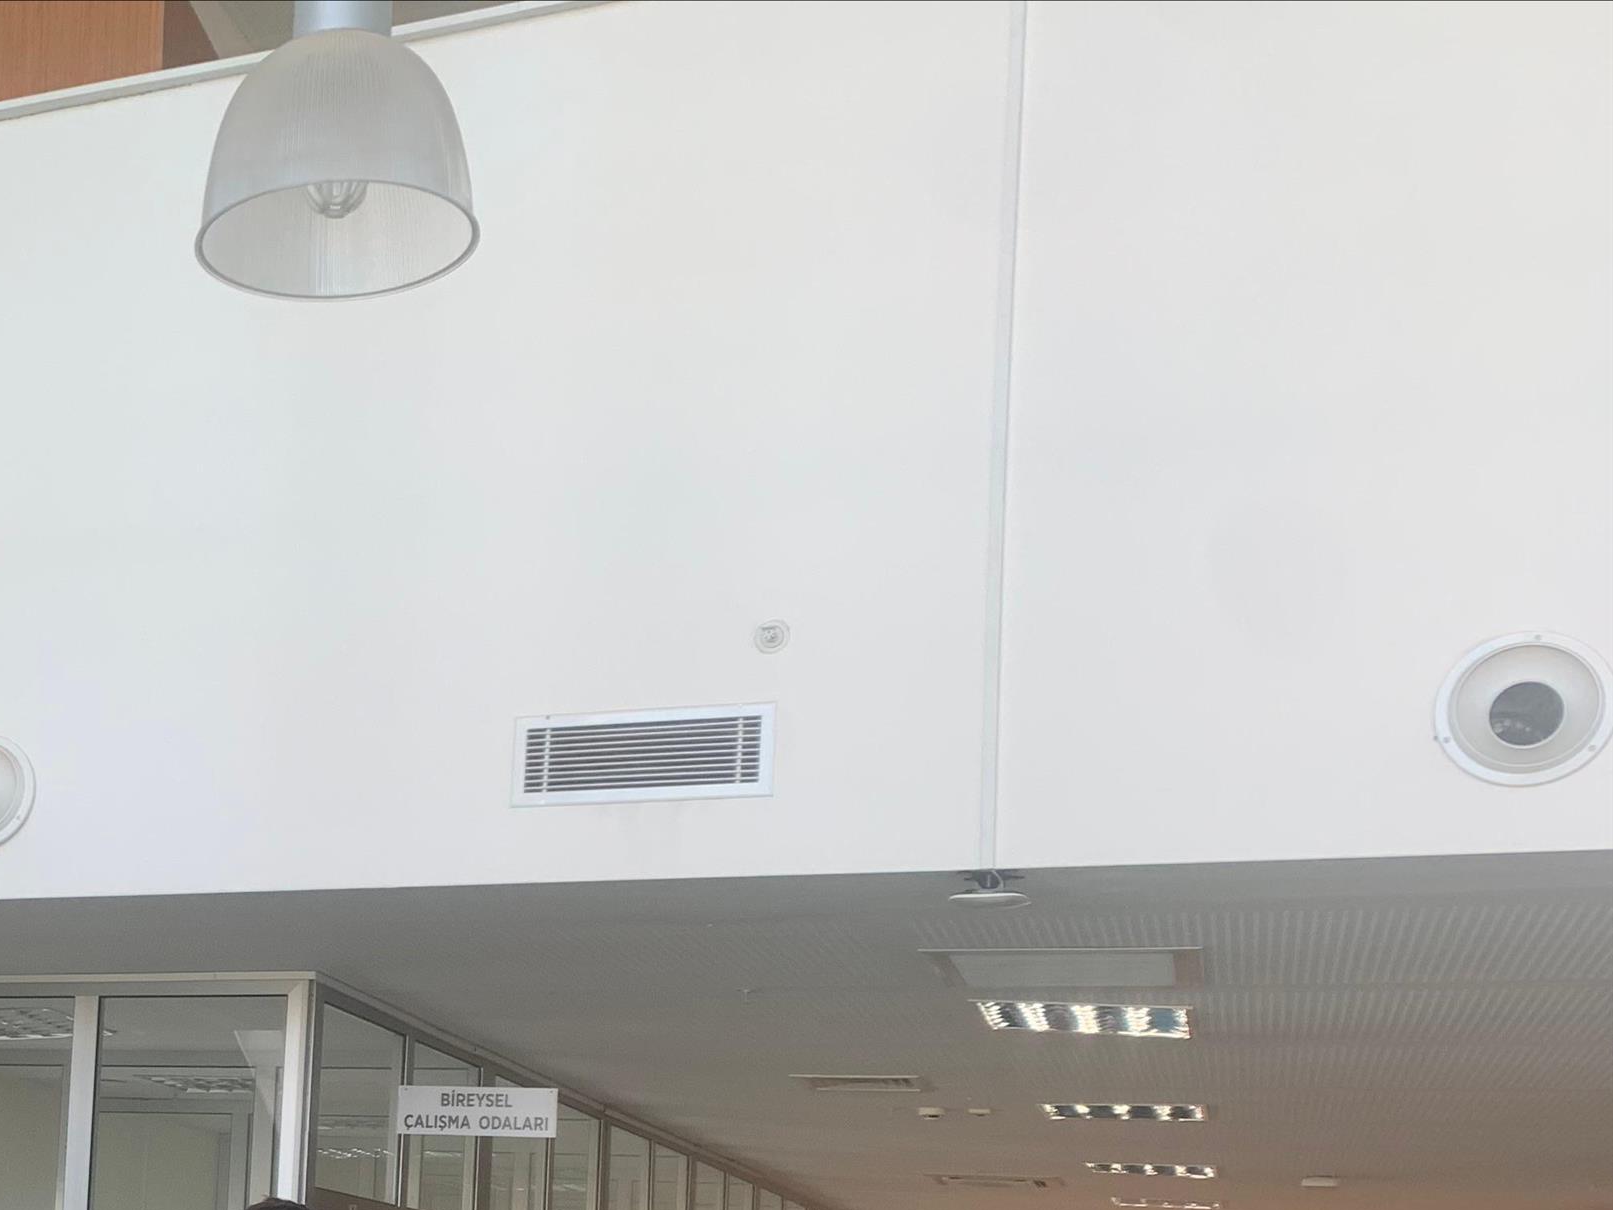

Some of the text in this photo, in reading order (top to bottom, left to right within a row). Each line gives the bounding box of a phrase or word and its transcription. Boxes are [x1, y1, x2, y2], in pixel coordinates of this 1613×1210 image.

[440, 1089, 513, 1108] BİREYSEL
[404, 1114, 549, 1132] ÇALIŞMA ODALARI
